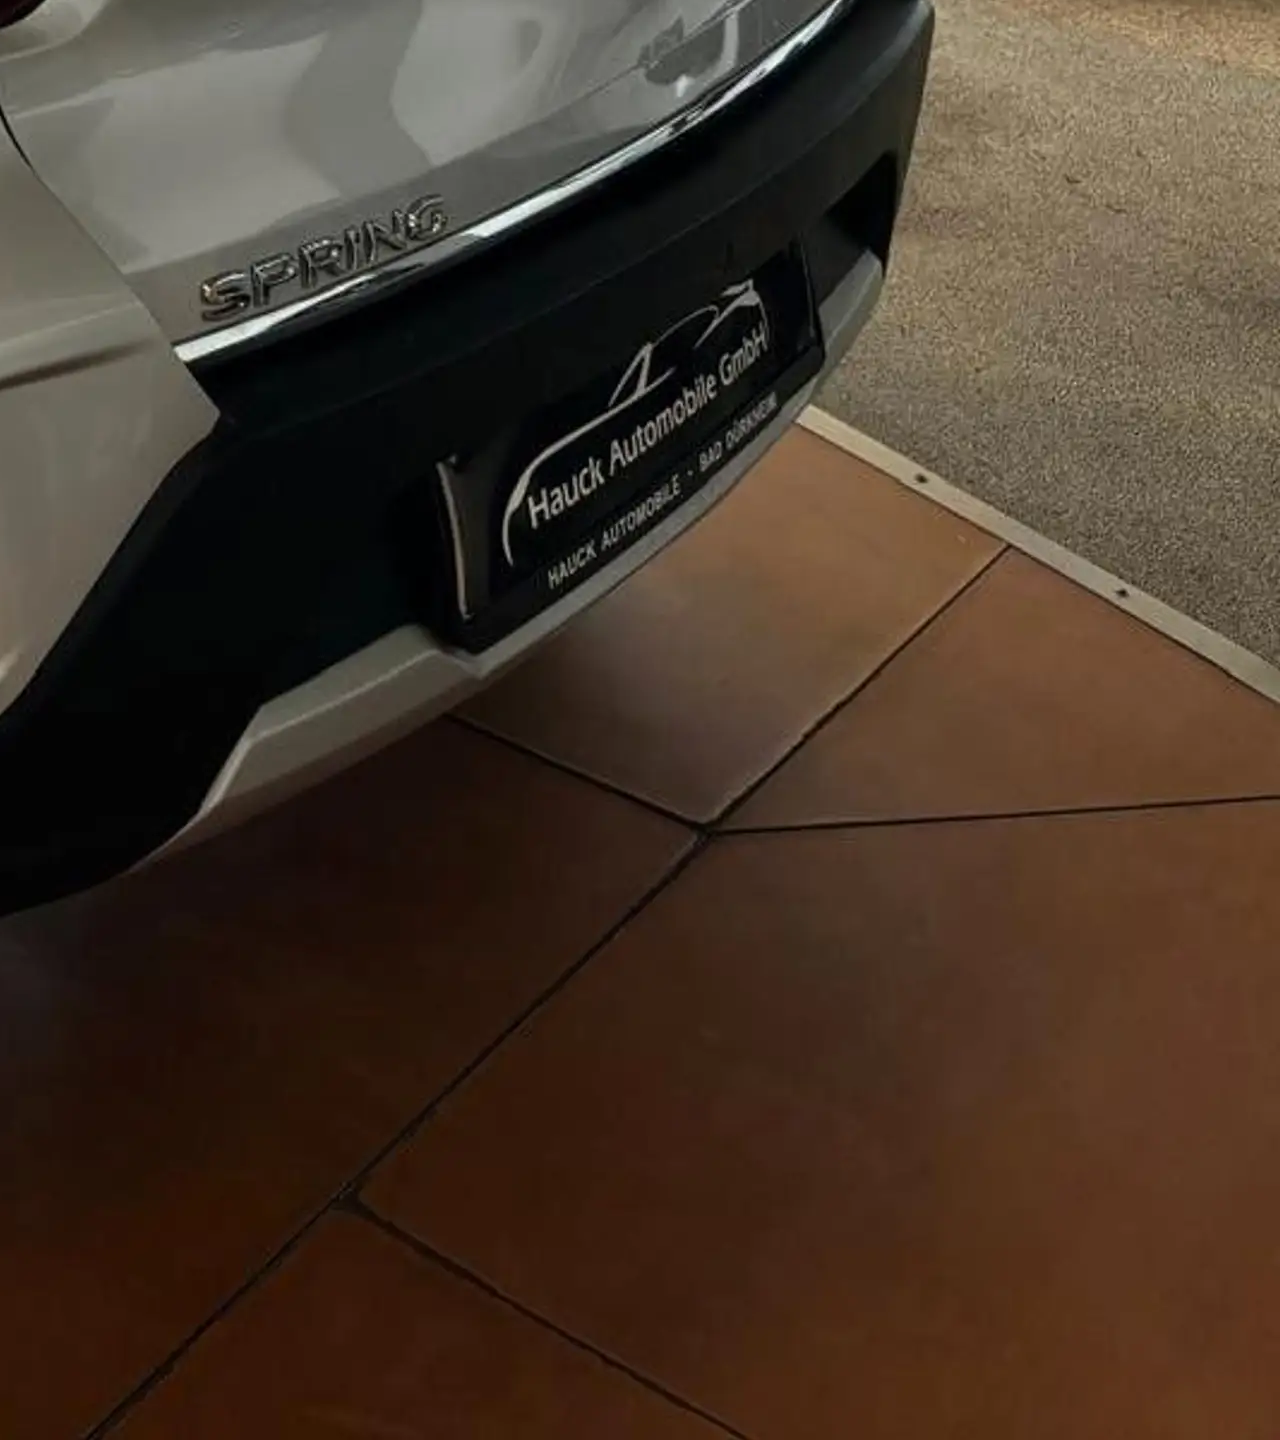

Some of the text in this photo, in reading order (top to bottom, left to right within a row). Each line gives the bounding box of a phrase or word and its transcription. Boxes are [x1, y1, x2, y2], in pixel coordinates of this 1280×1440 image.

[199, 193, 449, 322] SPRING
[528, 319, 770, 530] Hauck Automobile GmbH
[547, 539, 597, 589] HAUCK
[600, 472, 682, 549] AUTOMOBILE
[698, 444, 723, 472] BAD
